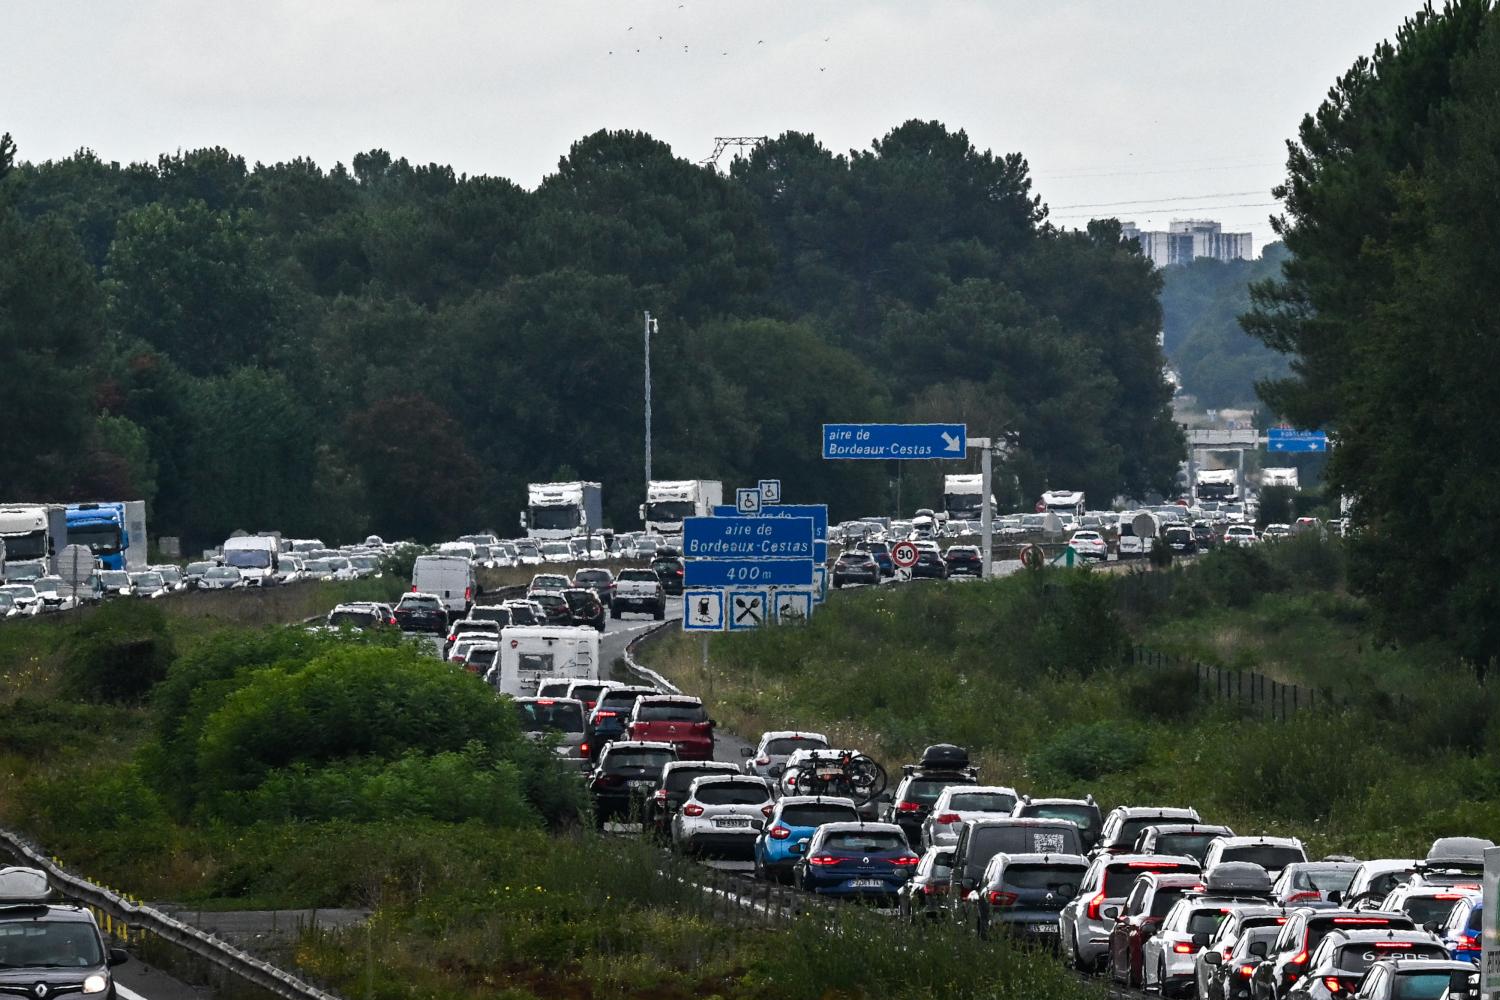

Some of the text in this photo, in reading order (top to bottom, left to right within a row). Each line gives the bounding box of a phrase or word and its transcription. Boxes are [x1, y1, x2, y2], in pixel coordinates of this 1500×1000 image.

[829, 428, 871, 441] aire de
[829, 443, 932, 455] Bordeaux-Cestas
[725, 523, 773, 536] aire de
[690, 539, 809, 553] Bordeaux-Cestas
[897, 549, 913, 560] 90
[726, 567, 772, 580] 400 m
